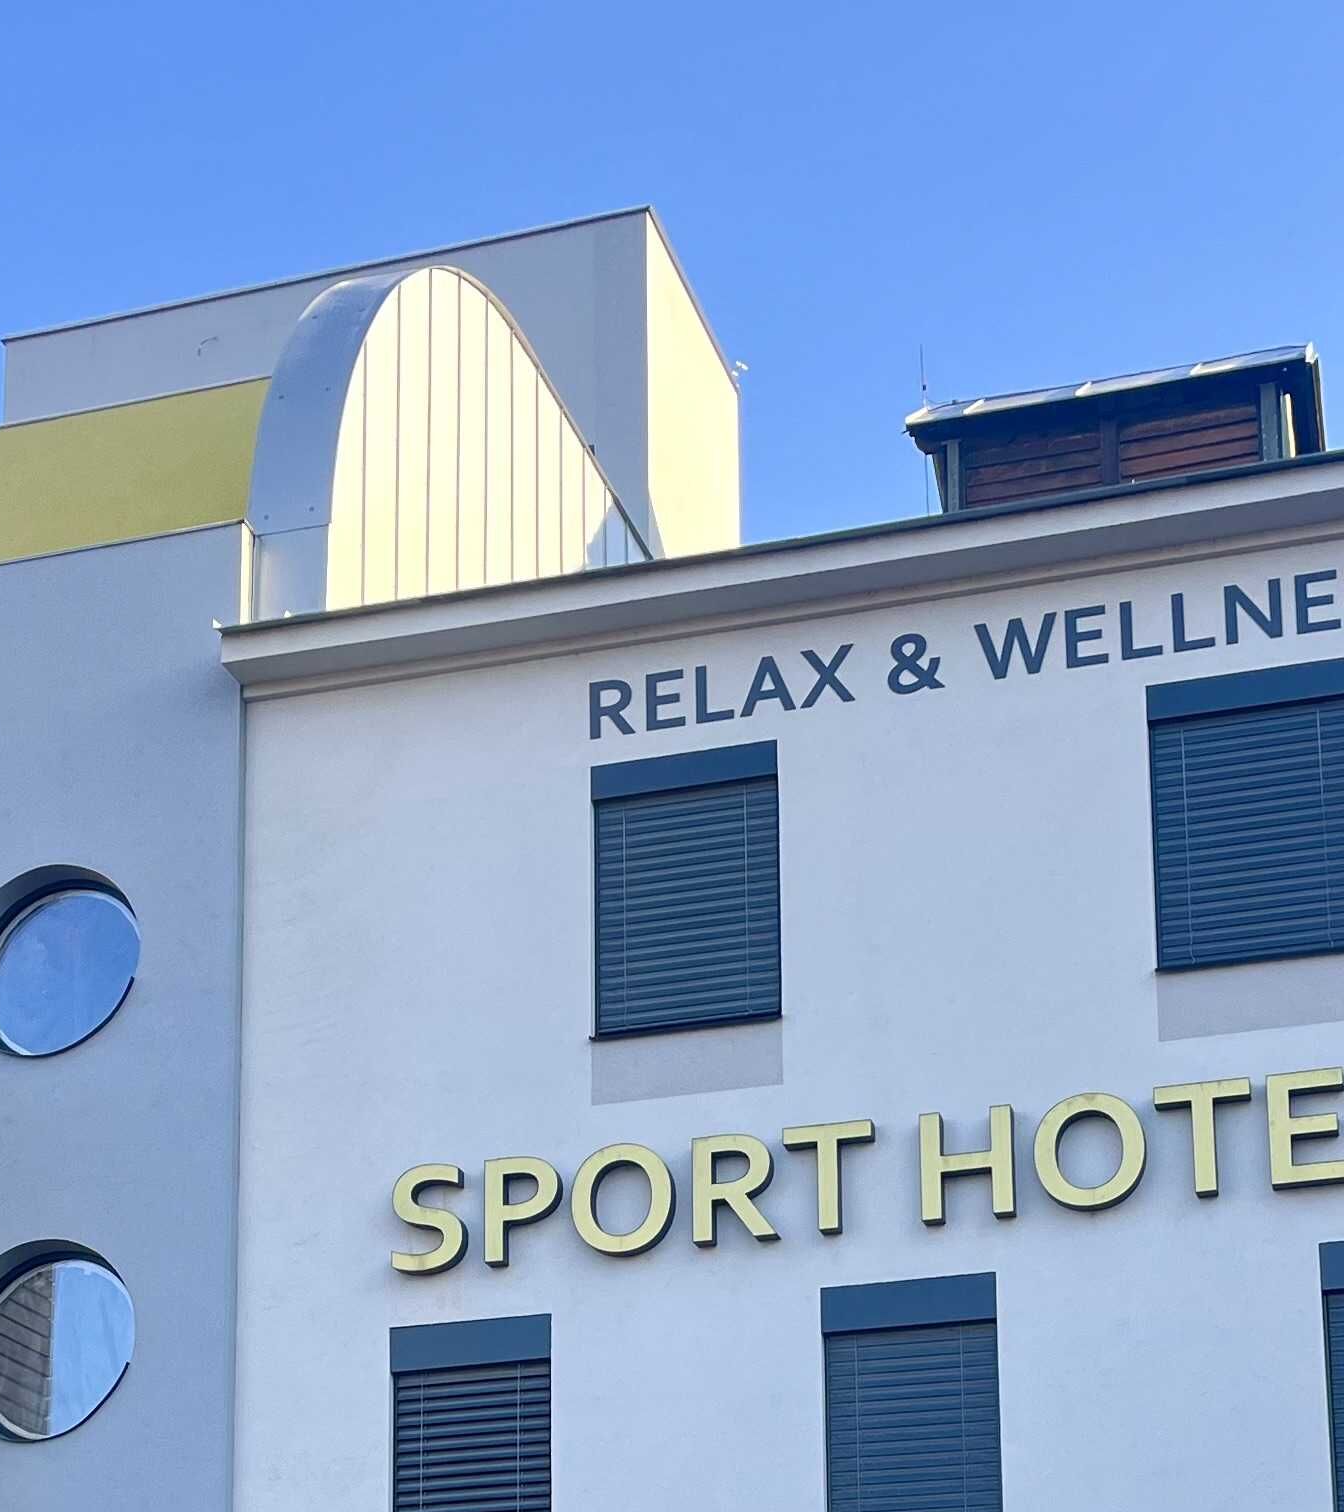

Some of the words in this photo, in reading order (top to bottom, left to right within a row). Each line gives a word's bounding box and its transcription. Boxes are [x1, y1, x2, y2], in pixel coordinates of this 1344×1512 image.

[587, 643, 856, 740] RELAX
[886, 632, 946, 695] &
[390, 1118, 876, 1277] SPORT
